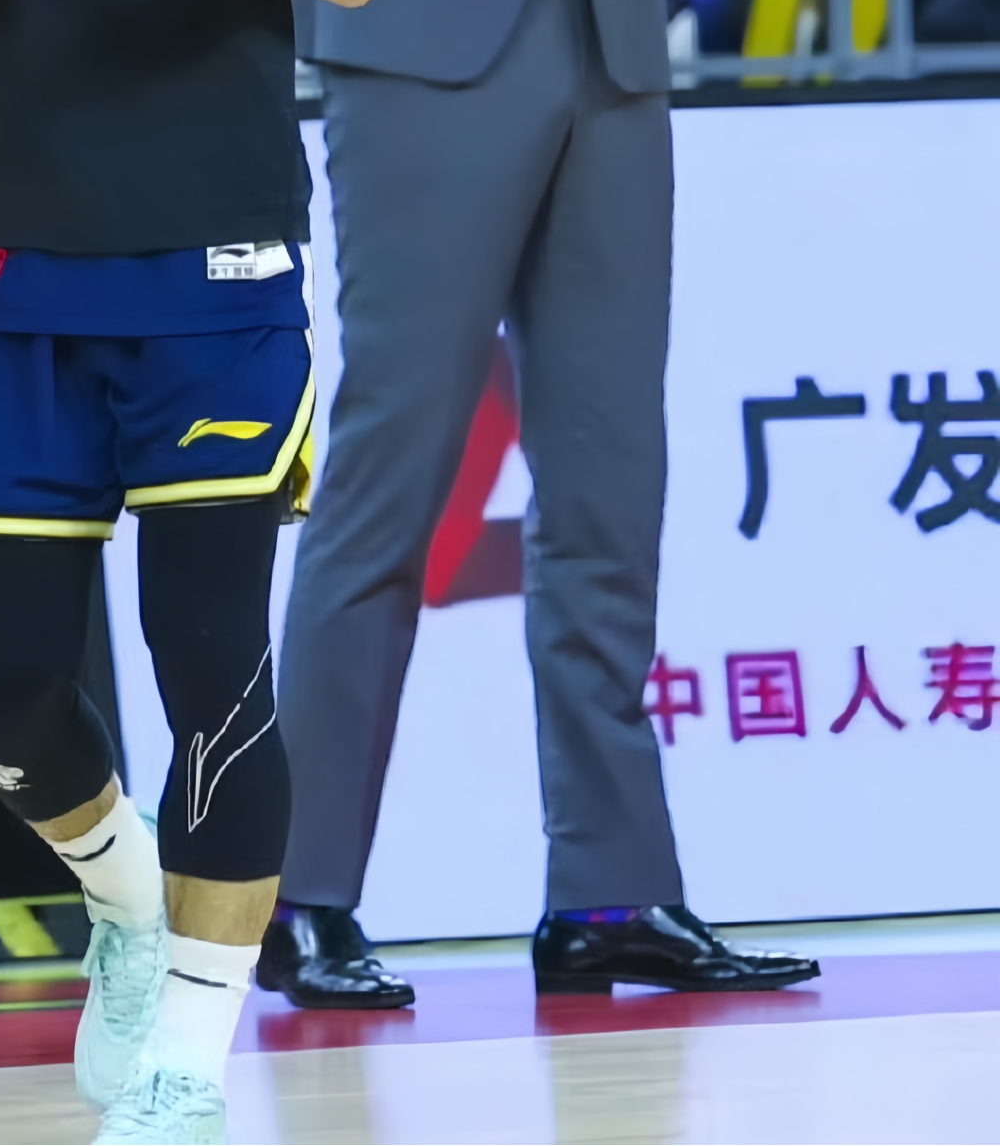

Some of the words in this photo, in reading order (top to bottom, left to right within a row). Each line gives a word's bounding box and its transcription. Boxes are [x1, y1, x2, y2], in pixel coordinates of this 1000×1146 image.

[738, 370, 1000, 541] 广发
[641, 643, 1000, 746] 中国人寿
